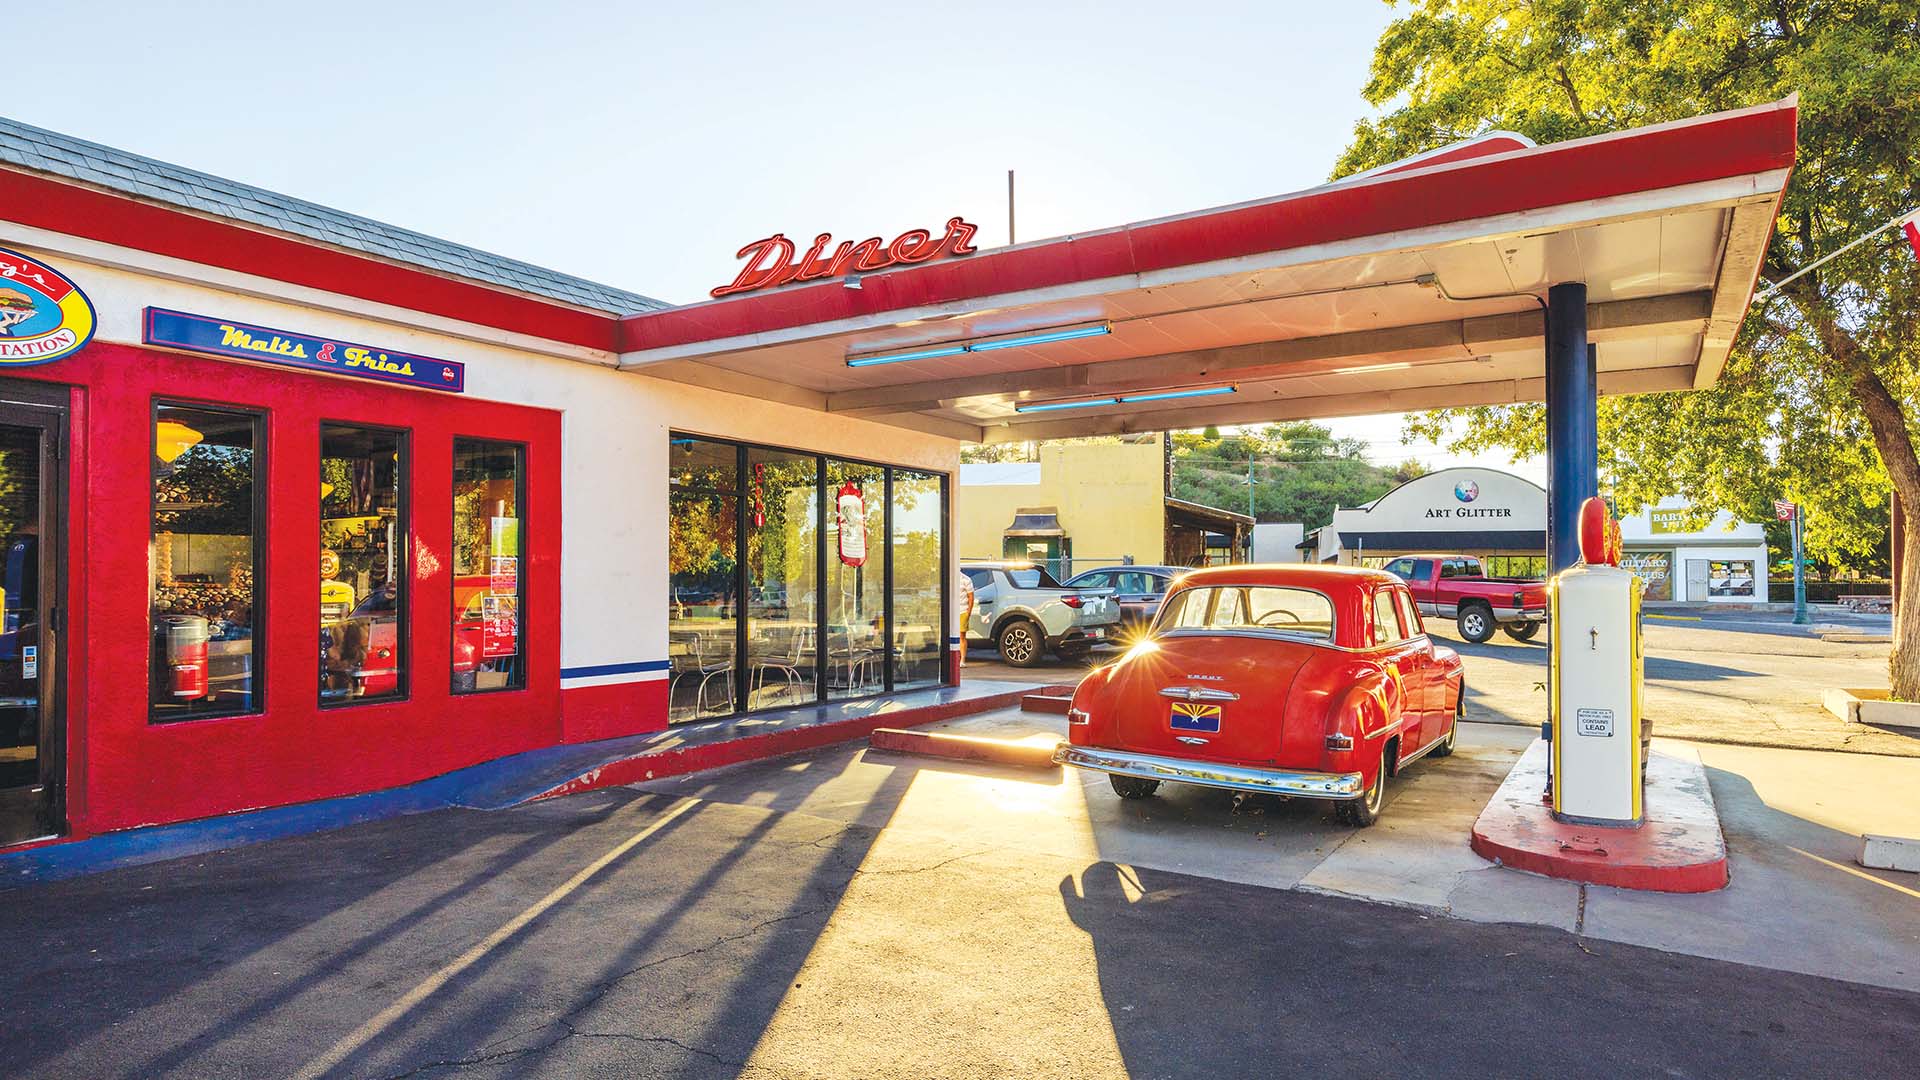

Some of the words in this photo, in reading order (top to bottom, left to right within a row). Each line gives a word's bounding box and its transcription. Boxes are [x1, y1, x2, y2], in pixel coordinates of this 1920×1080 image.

[710, 217, 978, 298] Diner
[0, 333, 71, 356] TATION
[219, 325, 308, 358] Malts
[316, 343, 337, 363] &
[344, 347, 415, 376] Fries
